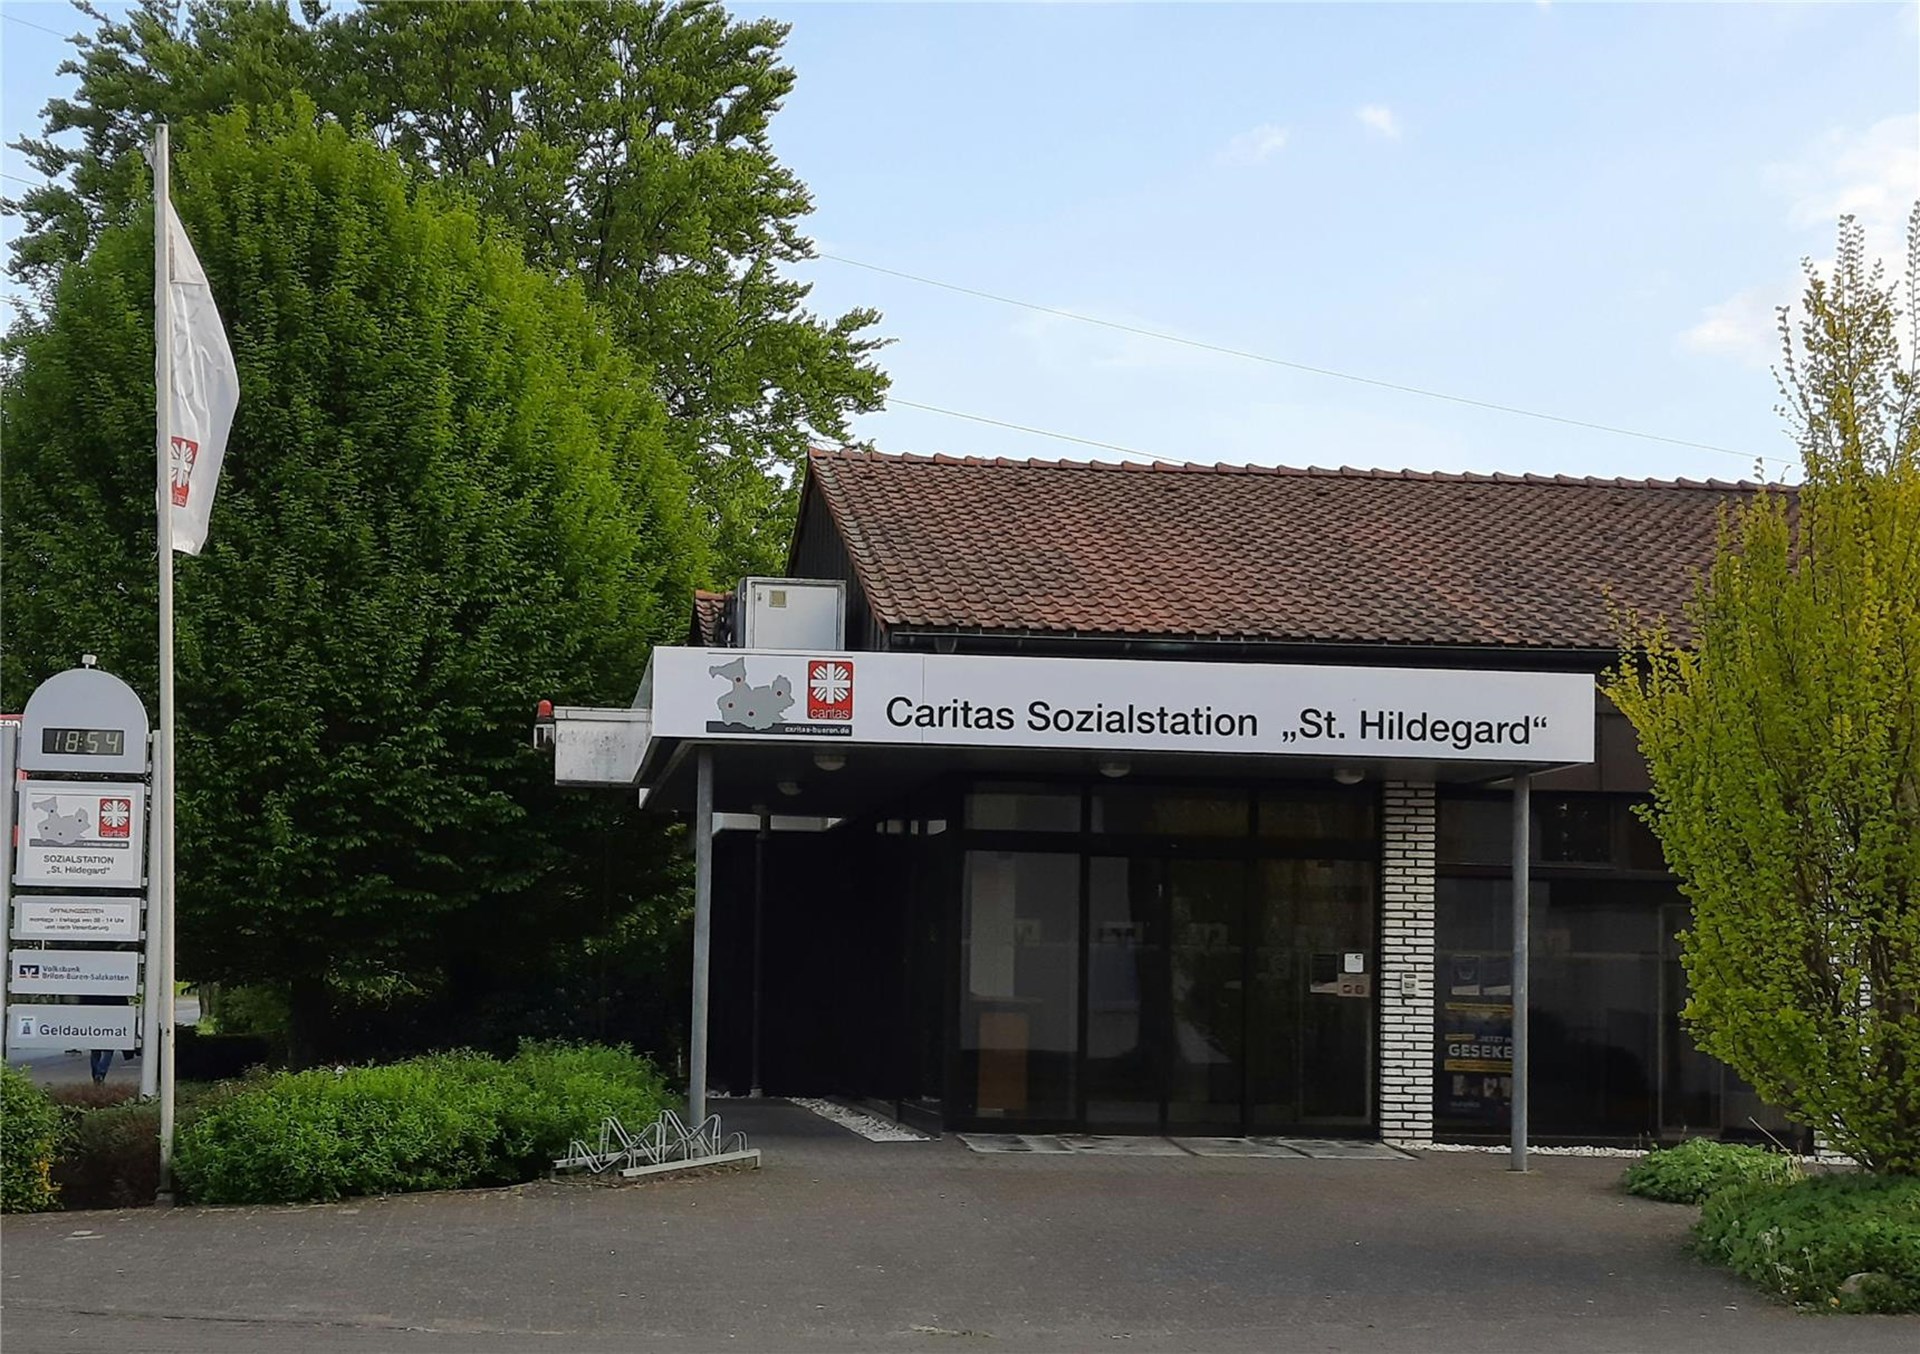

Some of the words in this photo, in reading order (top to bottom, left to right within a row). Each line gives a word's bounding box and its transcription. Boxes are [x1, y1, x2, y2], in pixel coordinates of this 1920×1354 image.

[810, 708, 850, 719] caritas
[886, 696, 1015, 730] Caritas
[1027, 700, 1258, 736] Sozialstation
[1360, 709, 1547, 750] Hildegard“
[55, 731, 119, 753] 18:54
[43, 854, 114, 864] SOZIALSTATION
[42, 965, 80, 973] Volksbank
[40, 1024, 127, 1037] Geldautomat
[1448, 1044, 1512, 1058] GESEKE
